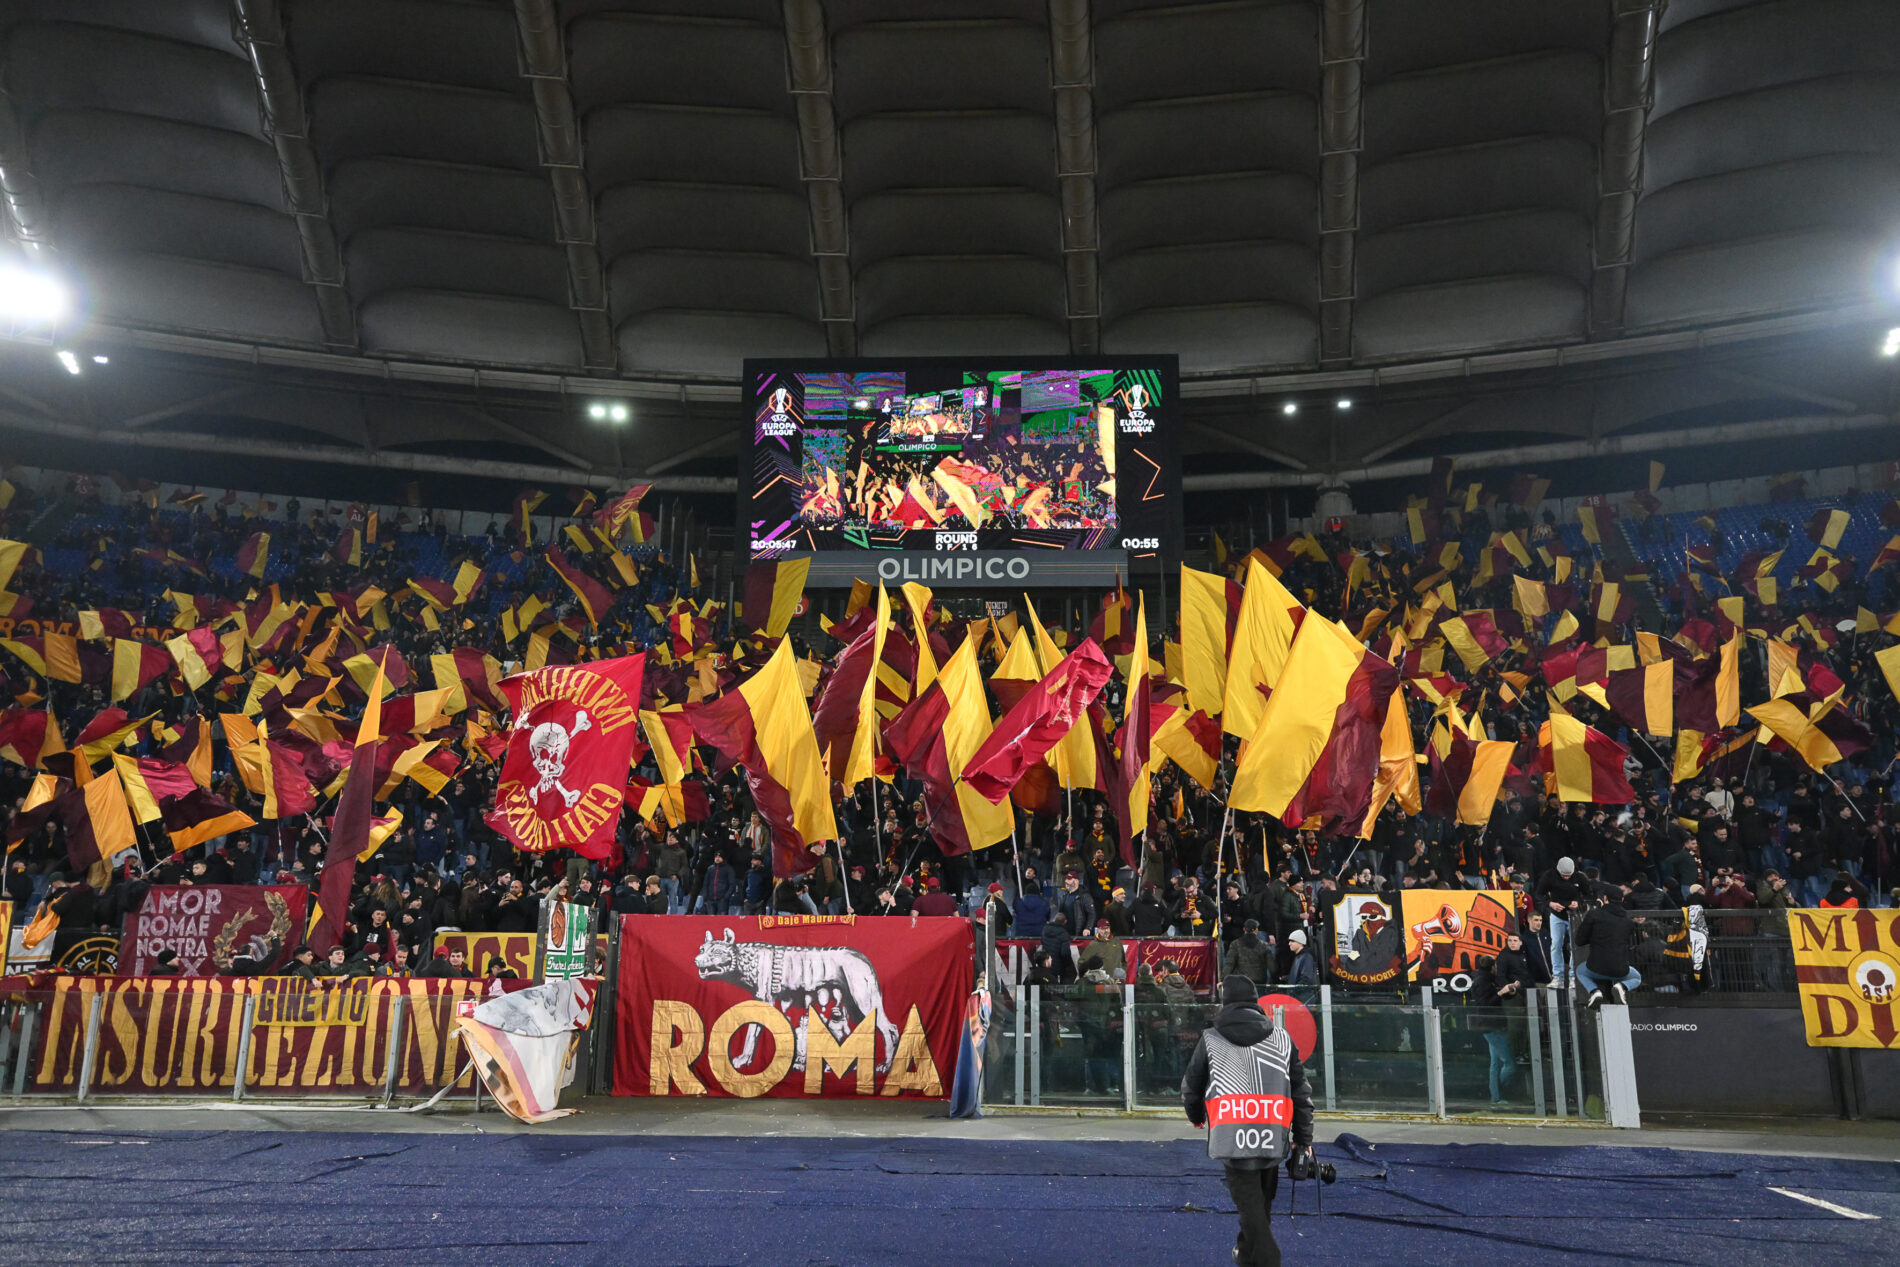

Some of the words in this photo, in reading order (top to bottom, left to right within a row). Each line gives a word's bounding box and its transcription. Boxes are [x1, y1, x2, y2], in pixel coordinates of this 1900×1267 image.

[762, 422, 796, 430] EUROPA
[898, 443, 937, 451] OLIMPICO
[751, 540, 797, 549] 20:05:47
[936, 534, 978, 544] ROUND
[1121, 538, 1159, 549] 00:55
[877, 557, 1030, 580] OLIMPICO
[140, 888, 223, 915] AMOR
[138, 915, 210, 937] ROMAE
[777, 915, 800, 926] Daje
[802, 914, 837, 924] Mauro!
[136, 937, 209, 958] NOSTRA
[1335, 967, 1359, 983] ROMA
[257, 977, 369, 1023] GINETTO
[1861, 984, 1894, 1003] asr
[1655, 1023, 1698, 1032] OLIMPICO
[649, 999, 944, 1098] ROMA
[1235, 1128, 1275, 1150] 002
